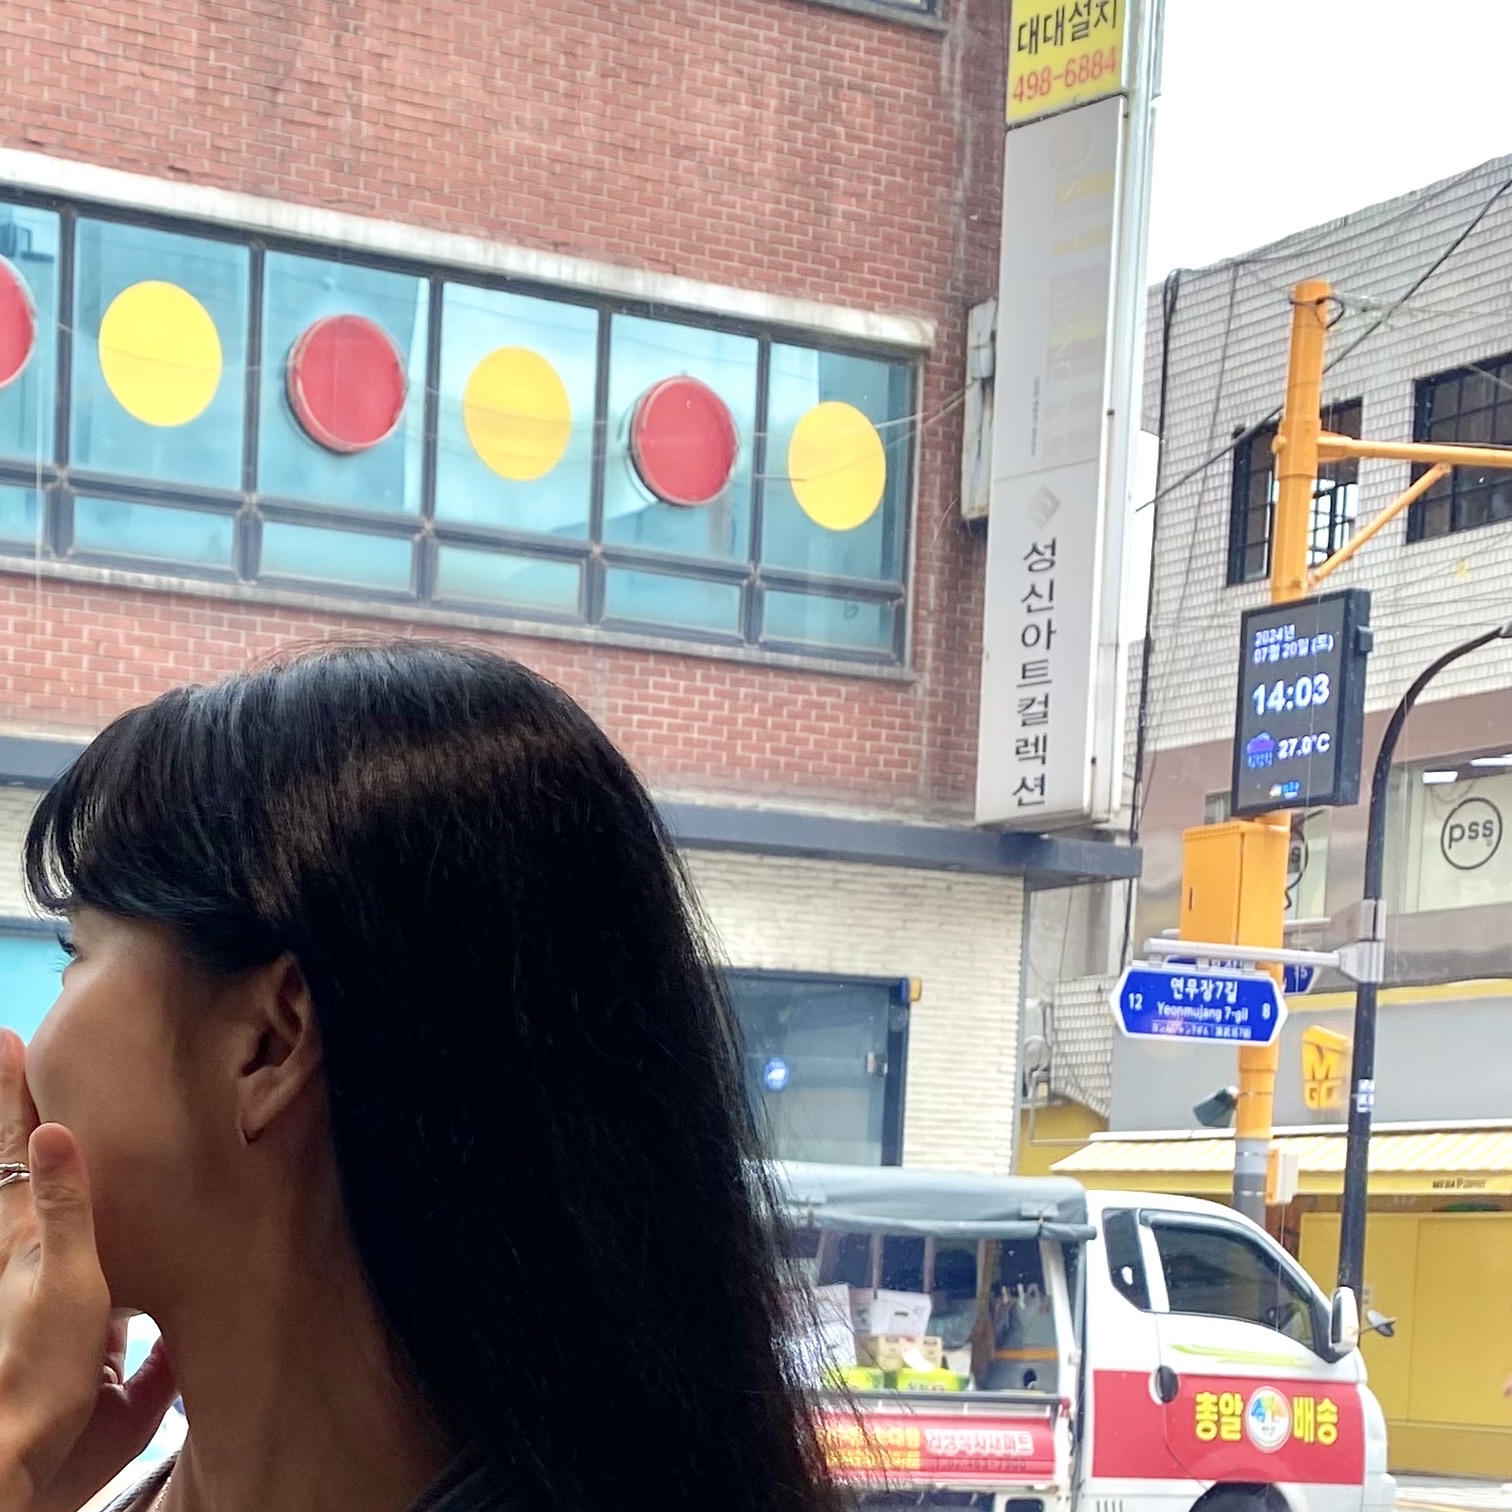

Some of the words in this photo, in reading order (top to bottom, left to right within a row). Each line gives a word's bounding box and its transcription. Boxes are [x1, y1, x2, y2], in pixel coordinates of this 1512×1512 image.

[1013, 45, 1117, 104] 498-6884
[1012, 537, 1057, 806] 성신아트컬렉션
[1252, 672, 1331, 715] 14:03
[1447, 818, 1495, 850] pss
[1128, 992, 1143, 1011] 12
[1170, 976, 1238, 1004] 연무장7길
[1157, 1002, 1222, 1021] Yeonmujang
[1195, 1391, 1244, 1442] 총알
[1292, 1396, 1339, 1446] 배송
